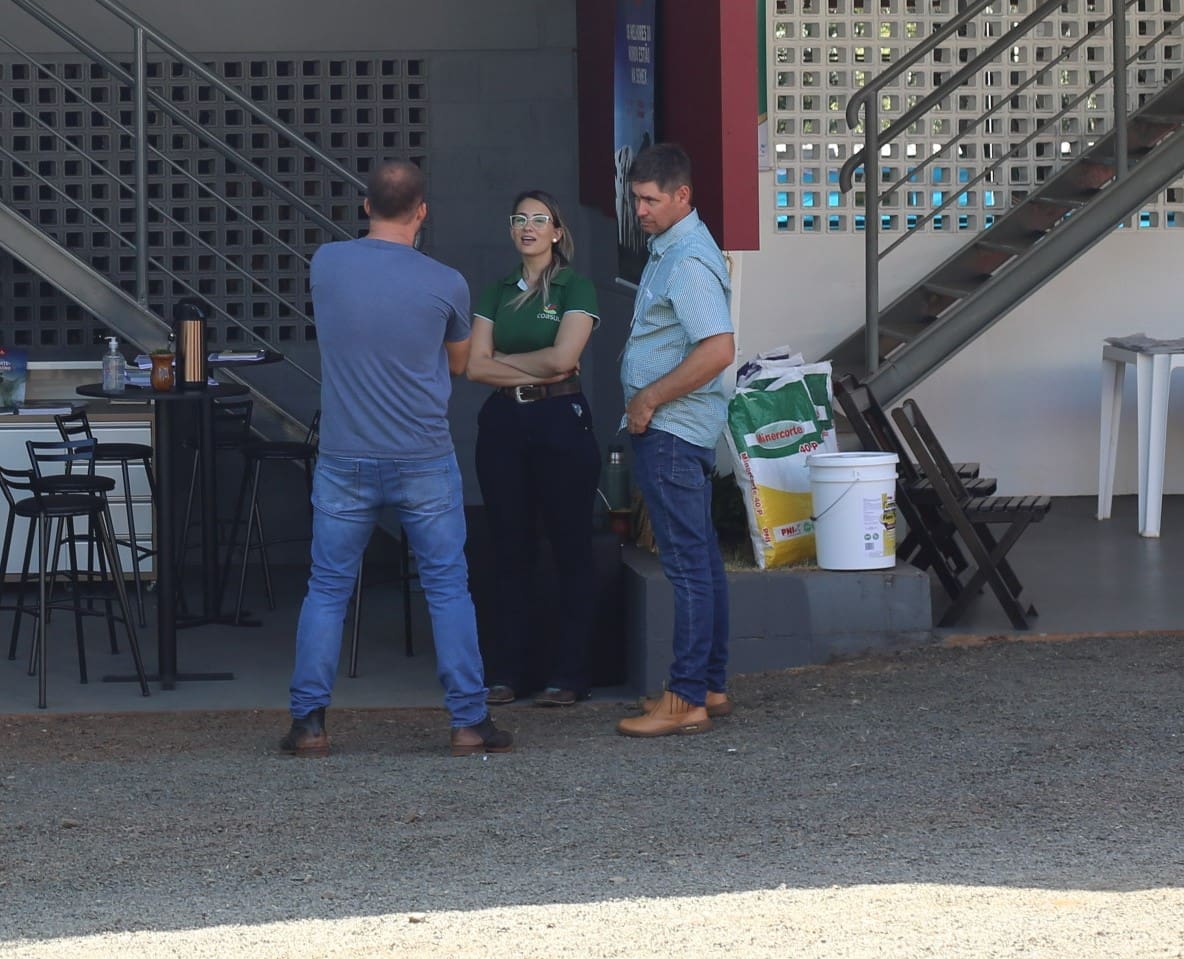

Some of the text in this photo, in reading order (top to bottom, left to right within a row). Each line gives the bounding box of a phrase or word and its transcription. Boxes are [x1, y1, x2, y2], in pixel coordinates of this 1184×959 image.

[755, 425, 804, 445] Minercorte
[799, 441, 819, 454] 40 P
